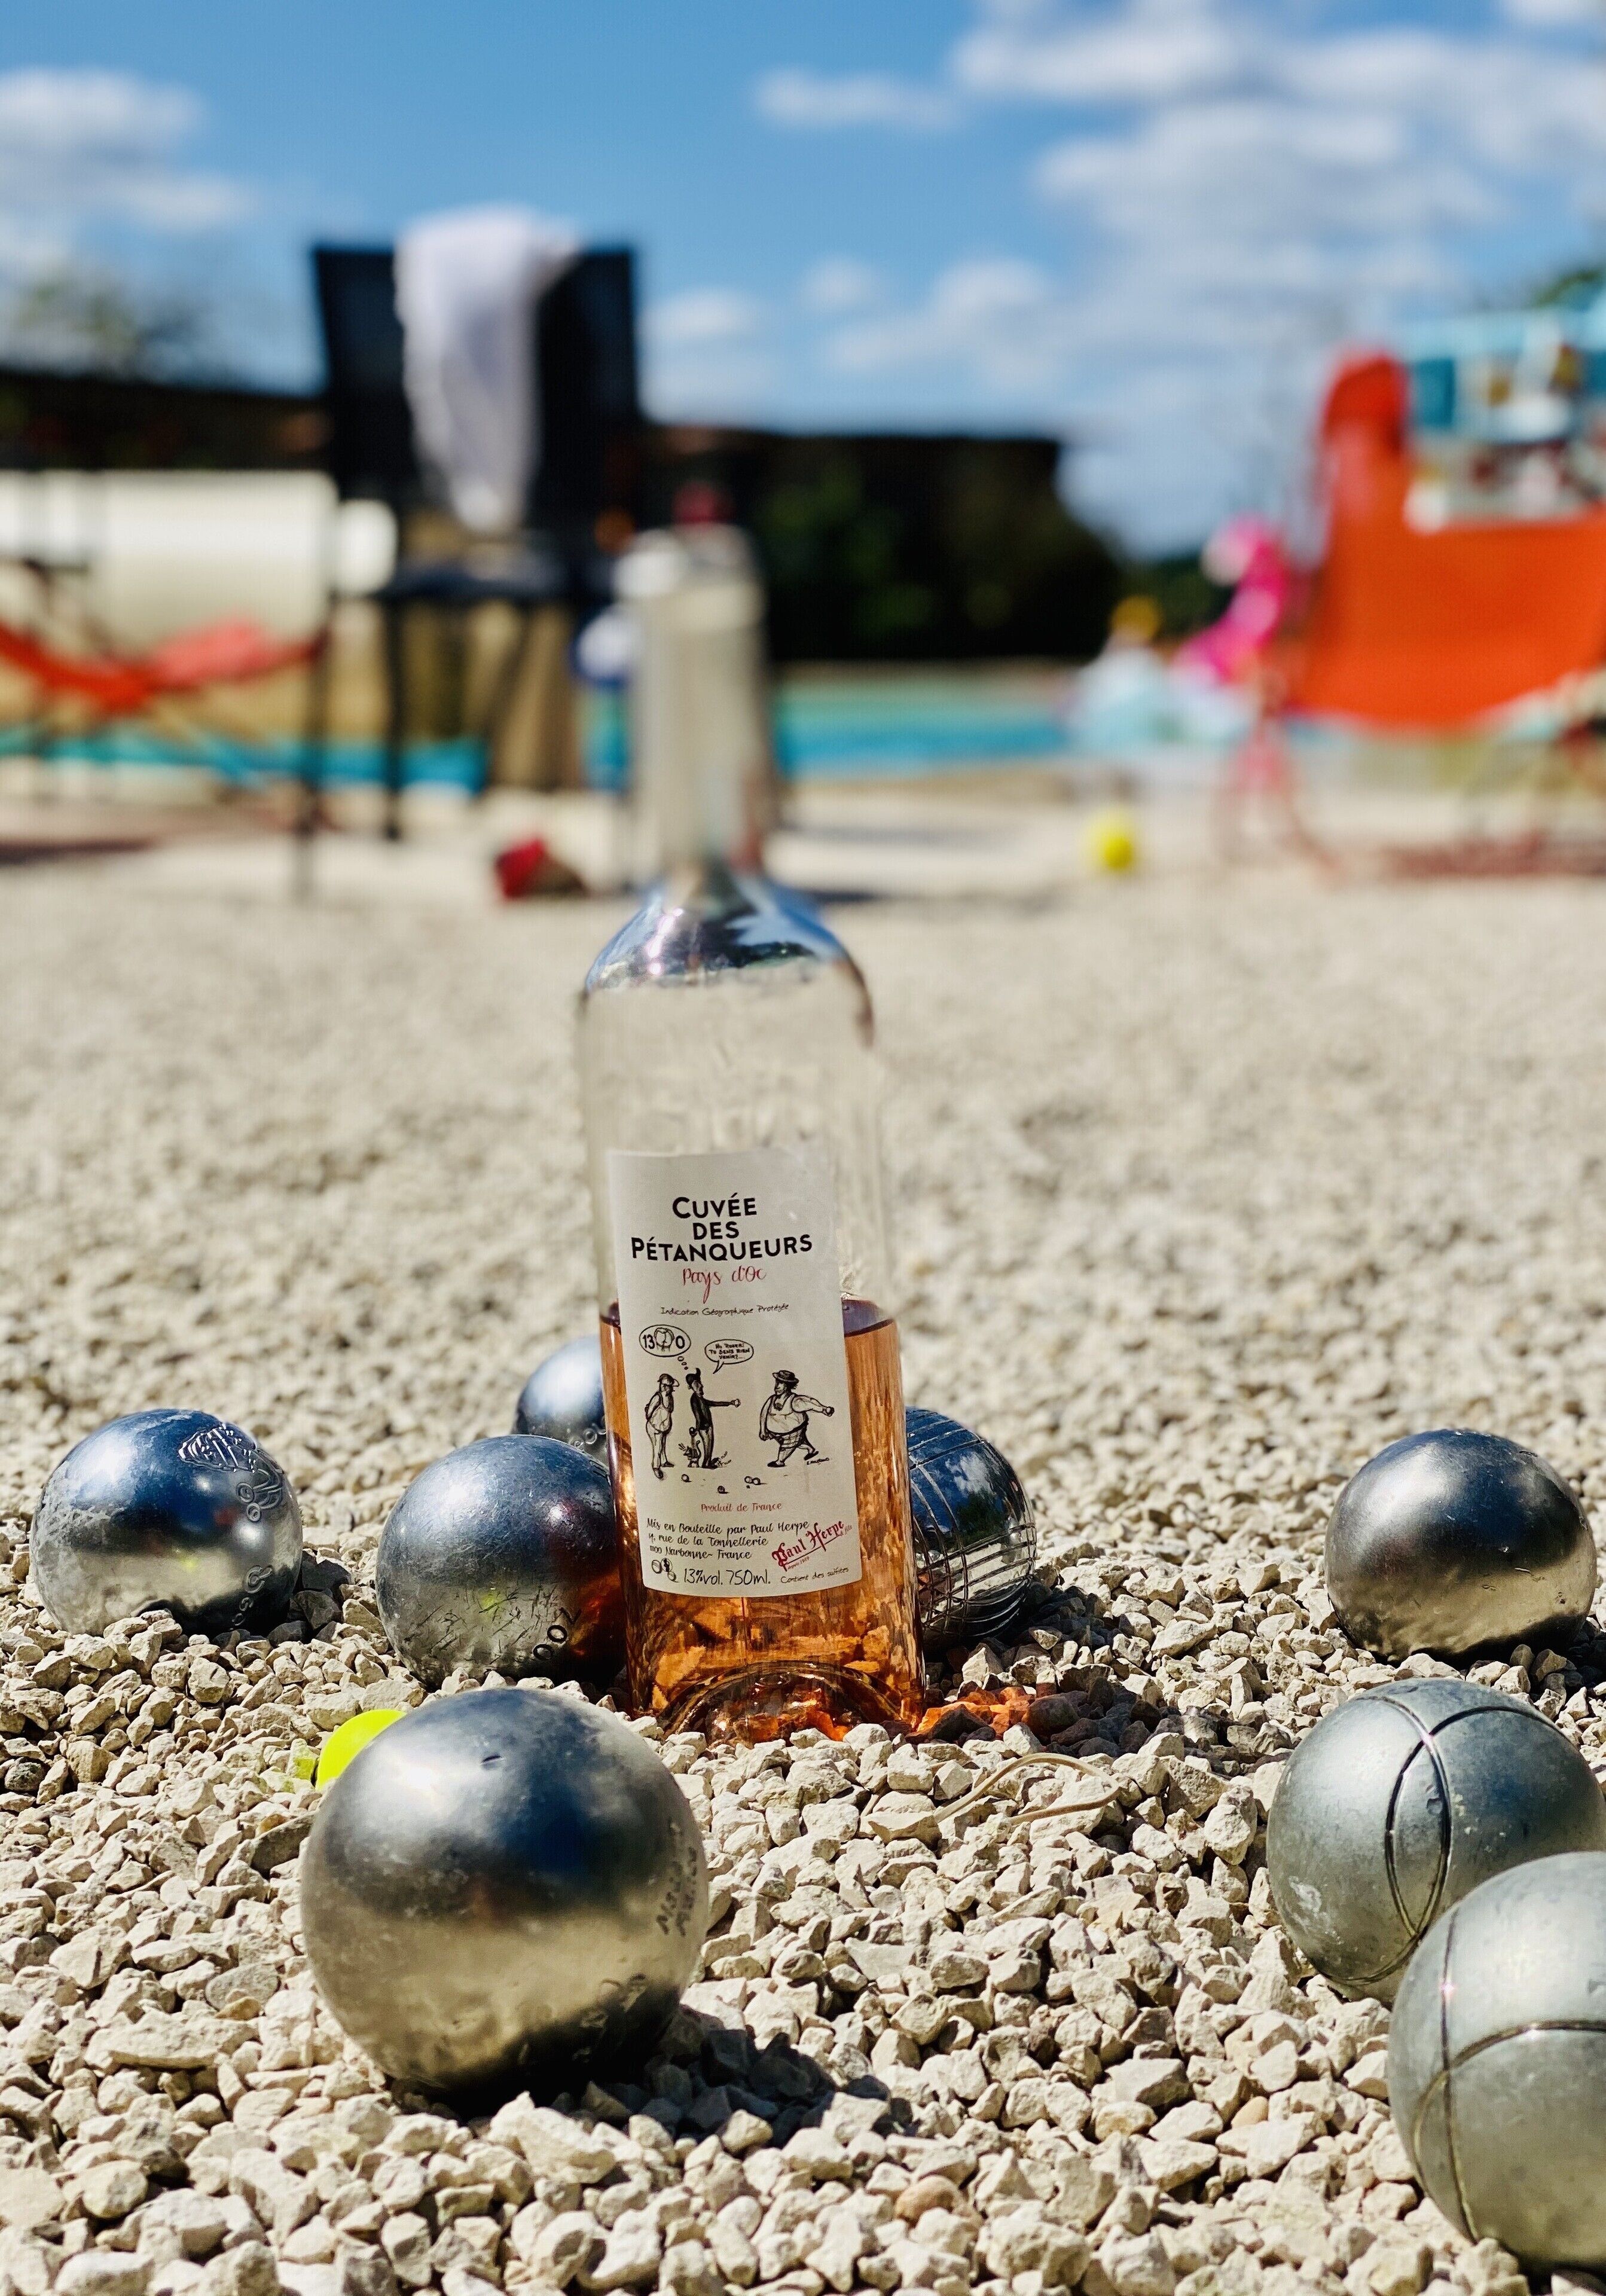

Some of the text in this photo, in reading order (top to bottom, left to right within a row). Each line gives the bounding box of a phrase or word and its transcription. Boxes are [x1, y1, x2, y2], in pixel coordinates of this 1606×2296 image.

[673, 1192, 757, 1219] CUVÉE
[693, 1221, 739, 1239] DES
[631, 1234, 812, 1262] PÉTANQUEURS
[701, 1502, 782, 1513] Produit de France
[664, 1523, 675, 1532] en
[679, 1523, 723, 1534] Bouteille
[726, 1526, 746, 1540] par
[751, 1522, 774, 1535] Paul
[778, 1521, 810, 1537] Herpe
[658, 1535, 674, 1543] rue
[677, 1535, 689, 1546] de
[693, 1536, 703, 1546] la
[707, 1535, 768, 1547] Tonnellerie
[717, 1549, 752, 1560] France
